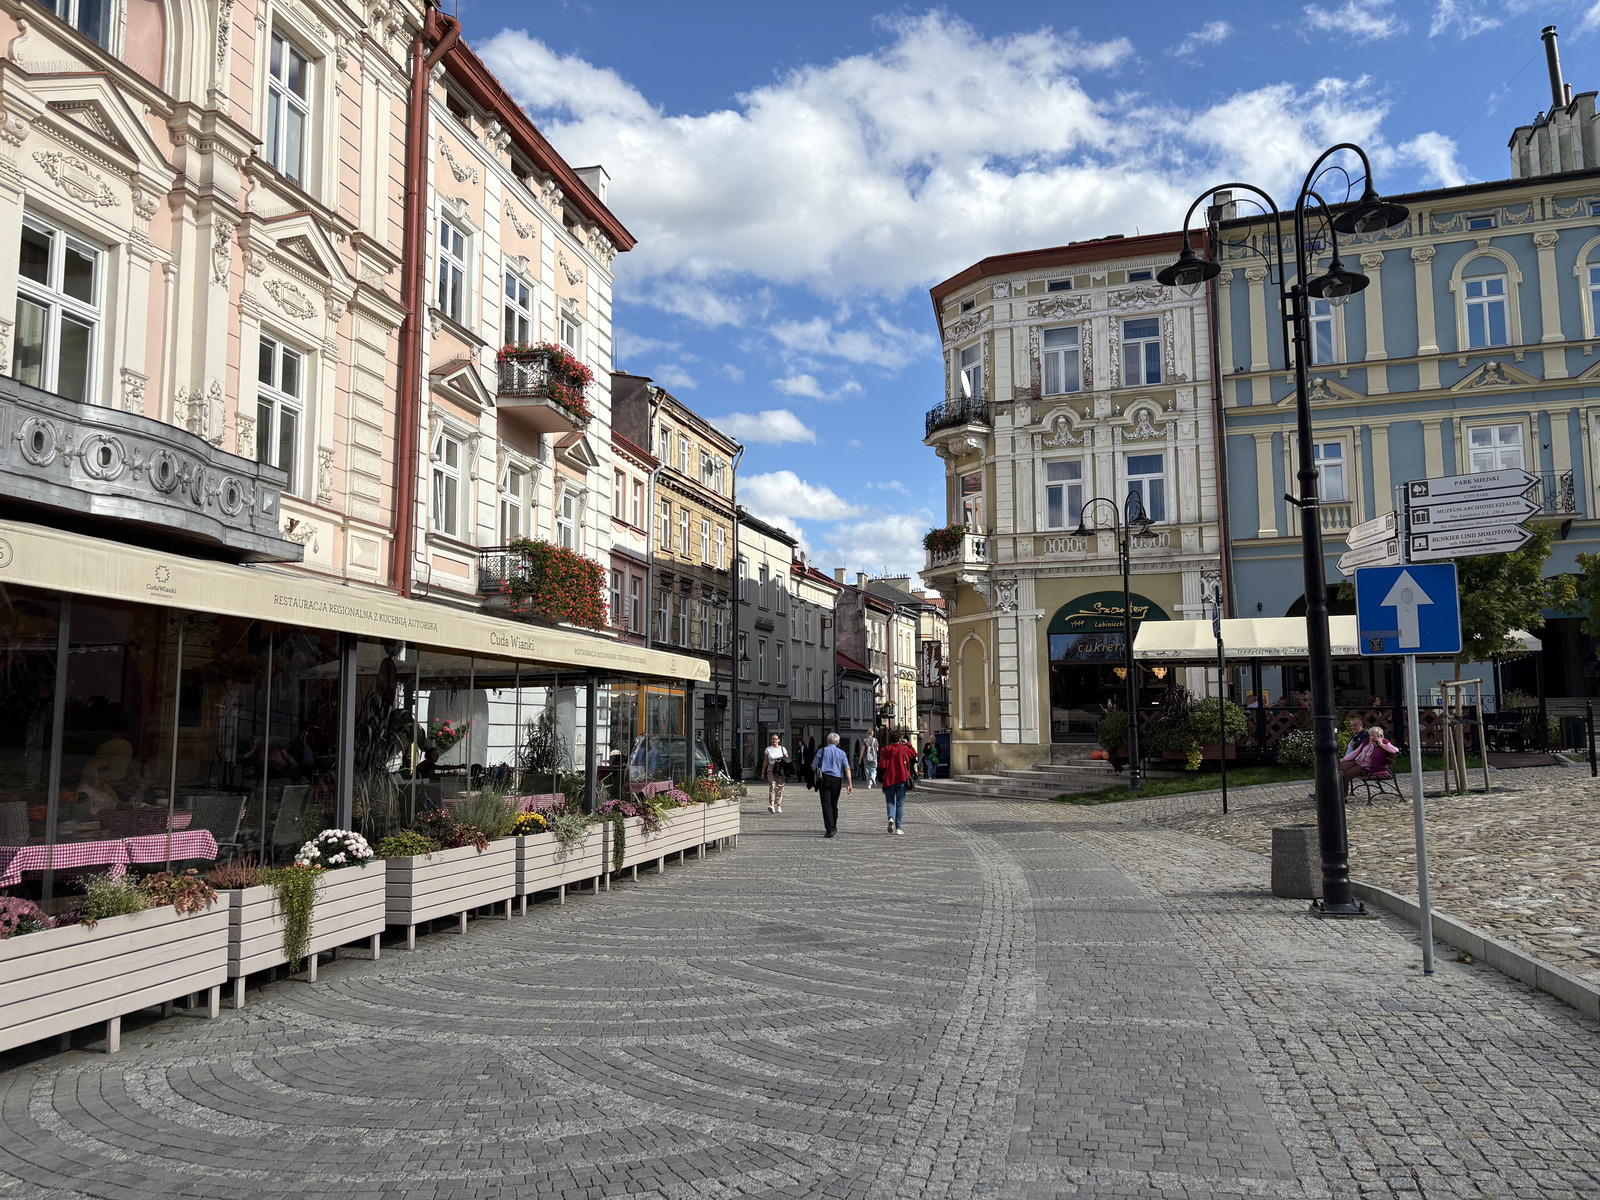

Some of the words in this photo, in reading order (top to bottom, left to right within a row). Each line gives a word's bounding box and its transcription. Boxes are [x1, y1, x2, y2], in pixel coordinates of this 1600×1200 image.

[1473, 475, 1500, 484] MIEJSKI
[1464, 500, 1520, 512] ARCHIDIECEZJALNE
[1432, 535, 1460, 543] BUNKIER
[274, 594, 328, 612] RESTAURACJA
[329, 604, 372, 621] REGIONALNA
[374, 612, 378, 621] Z
[378, 613, 407, 628] KUCHNIĄ
[408, 619, 438, 632] AUTORSKĄ
[490, 632, 509, 647] Cuda
[511, 636, 534, 651] Wianki
